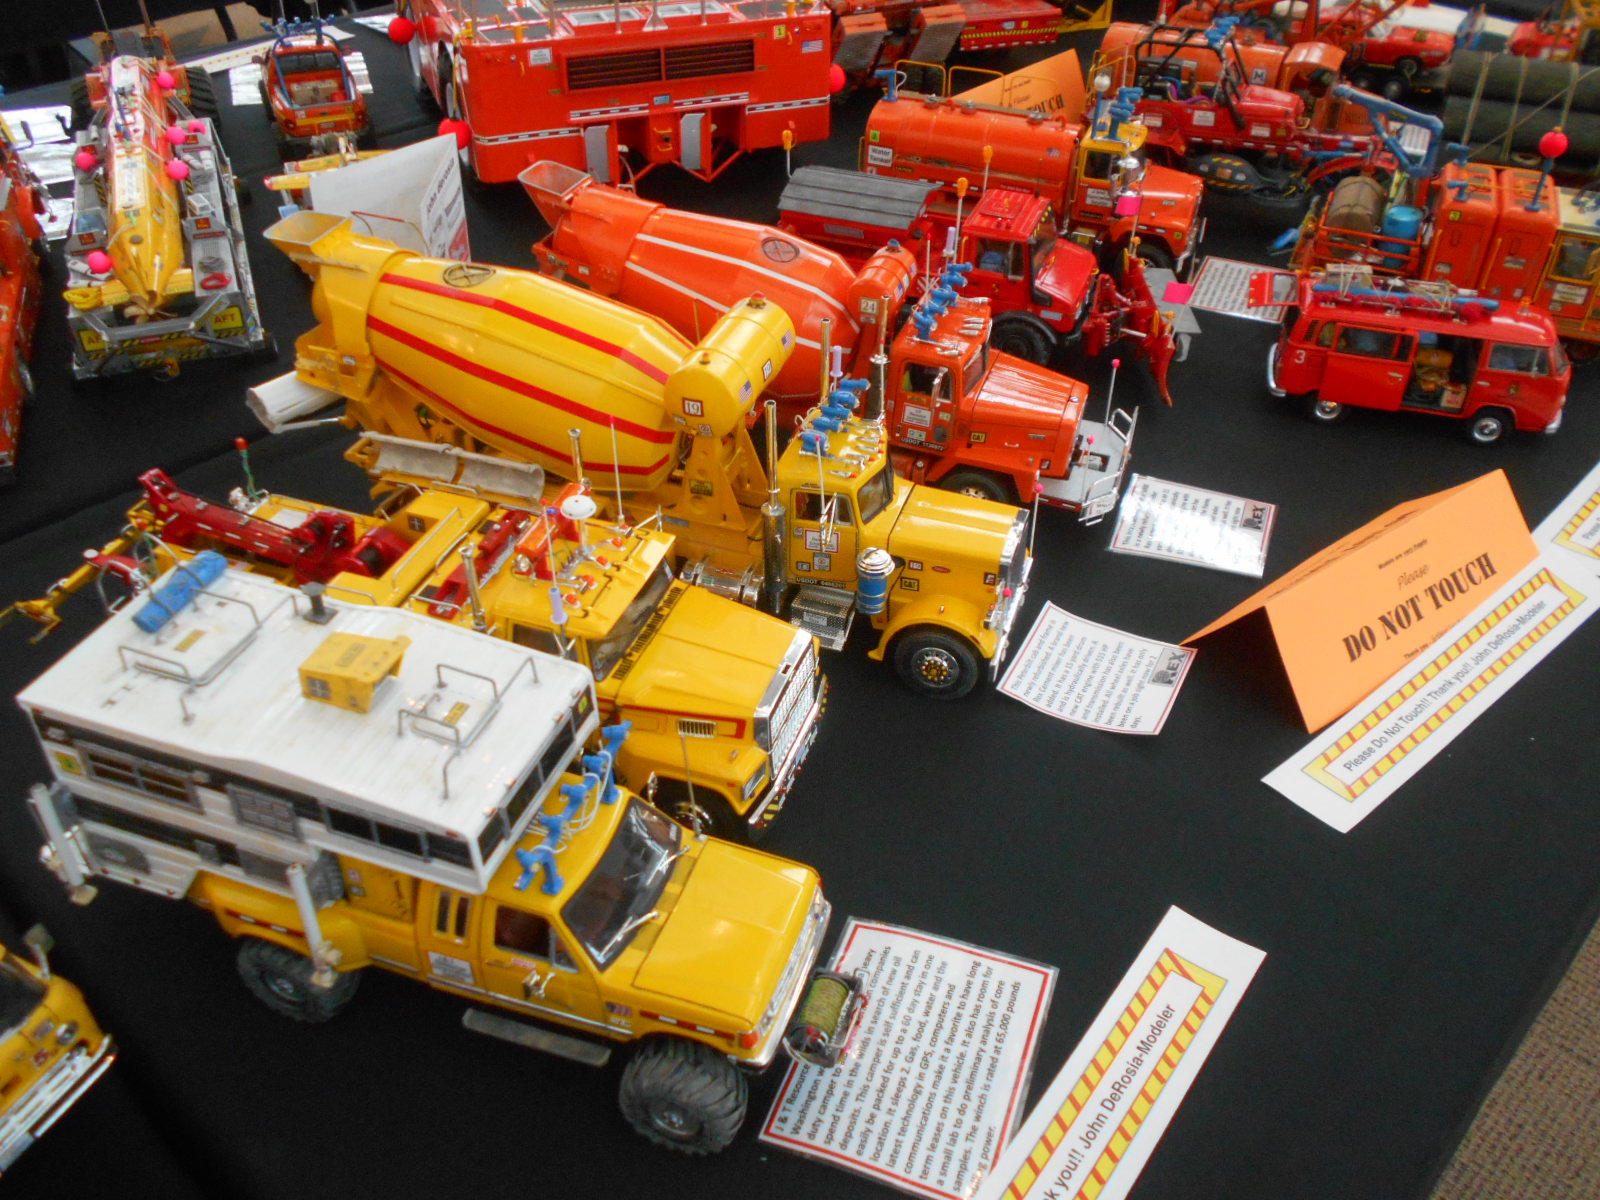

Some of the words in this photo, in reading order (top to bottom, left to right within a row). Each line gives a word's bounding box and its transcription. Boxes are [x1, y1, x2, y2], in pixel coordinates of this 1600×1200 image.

[863, 301, 875, 312] 24
[213, 313, 236, 325] AFT
[1295, 349, 1306, 364] 3
[685, 400, 701, 415] 19
[1397, 564, 1429, 589] Please
[1342, 625, 1376, 662] DO
[1377, 594, 1423, 640] NOT
[1424, 552, 1497, 610] TOUCH
[1342, 746, 1376, 772] Please
[1370, 736, 1388, 748] Do
[1383, 722, 1404, 737] Not
[1397, 697, 1429, 724] Touch!!
[1426, 679, 1455, 700] Thank
[1451, 662, 1473, 683] you!!
[1470, 648, 1492, 665] John
[1487, 600, 1545, 650] DeRosia-Modeler
[925, 955, 934, 970] one
[937, 961, 948, 974] the
[967, 961, 982, 978] long
[982, 967, 993, 978] for
[921, 971, 928, 979] in
[932, 976, 943, 992] and
[914, 980, 927, 997] stay
[946, 984, 956, 1000] and
[960, 980, 973, 1000] have
[977, 981, 989, 1002] room
[995, 981, 1005, 999] core
[1007, 982, 1021, 1014] pounds
[907, 999, 920, 1014] day
[923, 993, 936, 1017] water
[957, 1002, 966, 1010] to
[970, 1005, 982, 1019] has
[991, 999, 999, 1009] of
[902, 1015, 912, 1026] 60
[929, 1002, 950, 1048] computers
[944, 1012, 963, 1046] favorite
[965, 1021, 976, 1039] also
[980, 1012, 996, 1046] analysis
[996, 1014, 1011, 1044] 65,000
[895, 1036, 905, 1045] to
[912, 1021, 928, 1042] food,
[807, 1117, 824, 1140] duty
[818, 1079, 836, 1115] camper
[832, 1068, 842, 1077] to
[869, 947, 891, 988] companies
[824, 1114, 840, 1145] spend
[835, 1091, 850, 1113] time
[844, 1080, 854, 1088] in
[849, 1063, 860, 1077] the
[865, 1027, 875, 1035] in
[882, 986, 890, 996] of
[887, 969, 897, 985] new
[894, 956, 902, 967] oil
[839, 1107, 862, 1151] deposits.
[856, 1085, 870, 1102] This
[866, 1048, 883, 1083] camper
[890, 982, 909, 1020] sufficient
[905, 965, 915, 980] and
[911, 951, 919, 964] can
[892, 1047, 901, 1059] up
[994, 1045, 1002, 1055] at
[905, 1045, 920, 1064] Gas,
[920, 1050, 935, 1070] GPS,
[883, 1061, 894, 1074] for
[918, 1072, 926, 1081] in
[932, 1064, 946, 1090] make
[951, 1052, 966, 1084] vehicle.
[963, 1048, 986, 1102] preliminary
[986, 1056, 999, 1082] rated
[873, 1076, 890, 1111] packed
[891, 1077, 907, 1107] sleeps
[944, 1087, 956, 1104] this
[981, 1084, 991, 1092] is
[1054, 1148, 1084, 1191] you!!
[1079, 1113, 1108, 1149] John
[1099, 1004, 1175, 1112] DeRosia-Modeler
[790, 1079, 821, 1135] Washington
[897, 1083, 924, 1137] technology
[940, 1107, 949, 1119] on
[957, 1103, 968, 1116] do
[974, 1094, 987, 1122] winch
[865, 1113, 876, 1125] be
[953, 1118, 963, 1129] to
[856, 1127, 873, 1156] easily
[870, 1122, 891, 1162] location.
[904, 1092, 937, 1174] communications
[927, 1122, 944, 1152] leases
[947, 1132, 959, 1147] lab
[965, 1125, 978, 1142] The
[886, 1139, 903, 1168] latest
[981, 1127, 994, 1161] power.
[919, 1155, 933, 1180] term
[940, 1149, 953, 1177] small
[953, 1148, 972, 1192] samples.
